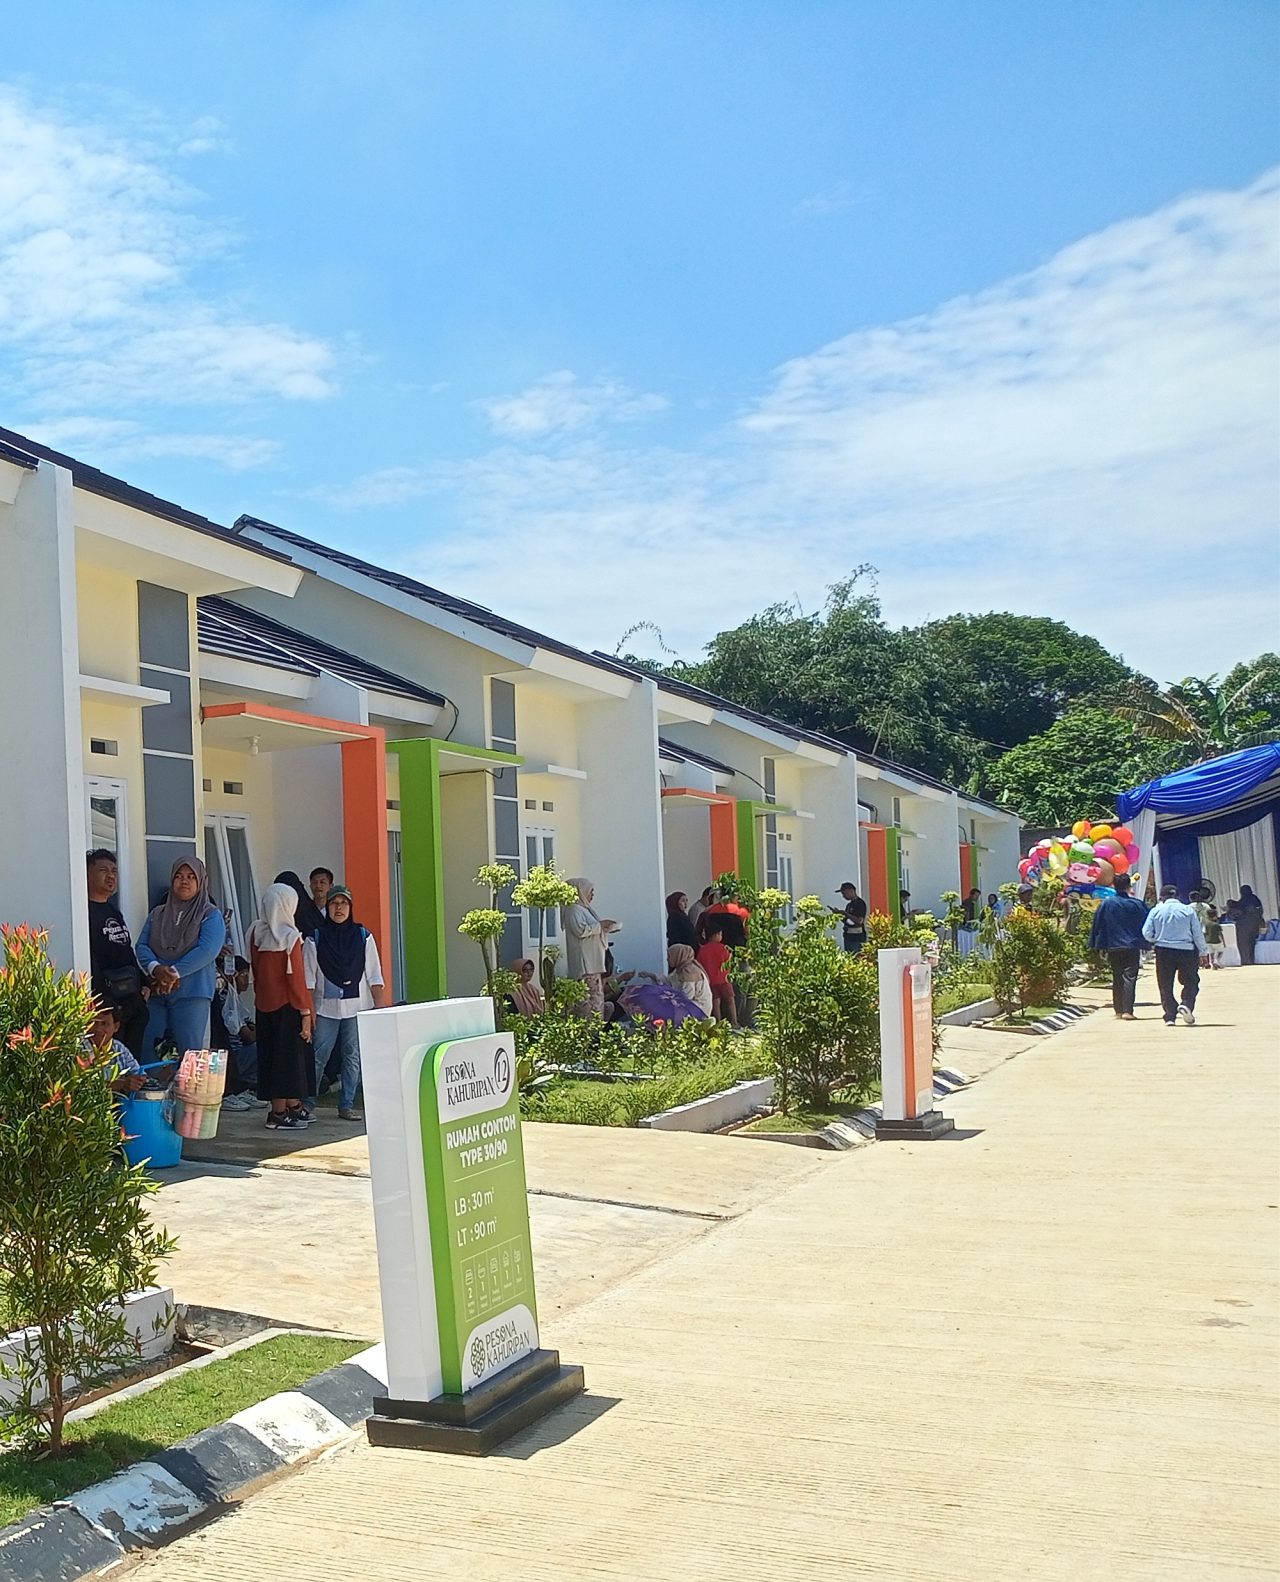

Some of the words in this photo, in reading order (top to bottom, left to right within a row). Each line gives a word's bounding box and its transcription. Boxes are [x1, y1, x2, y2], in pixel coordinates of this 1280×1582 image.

[445, 1061, 476, 1083] PESONA
[497, 1060, 507, 1083] 12
[446, 1076, 496, 1105] KAHURIPAN
[446, 1124, 480, 1150] RUMAH
[481, 1114, 516, 1139] CONTOH
[460, 1146, 484, 1168] TYPE
[484, 1139, 508, 1161] 30/90
[454, 1197, 467, 1217] LB
[471, 1191, 483, 1210] 30
[457, 1227, 467, 1247] LT
[474, 1220, 486, 1240] 90
[485, 1320, 517, 1351] PESONA
[487, 1330, 530, 1369] KAHURIPAN
